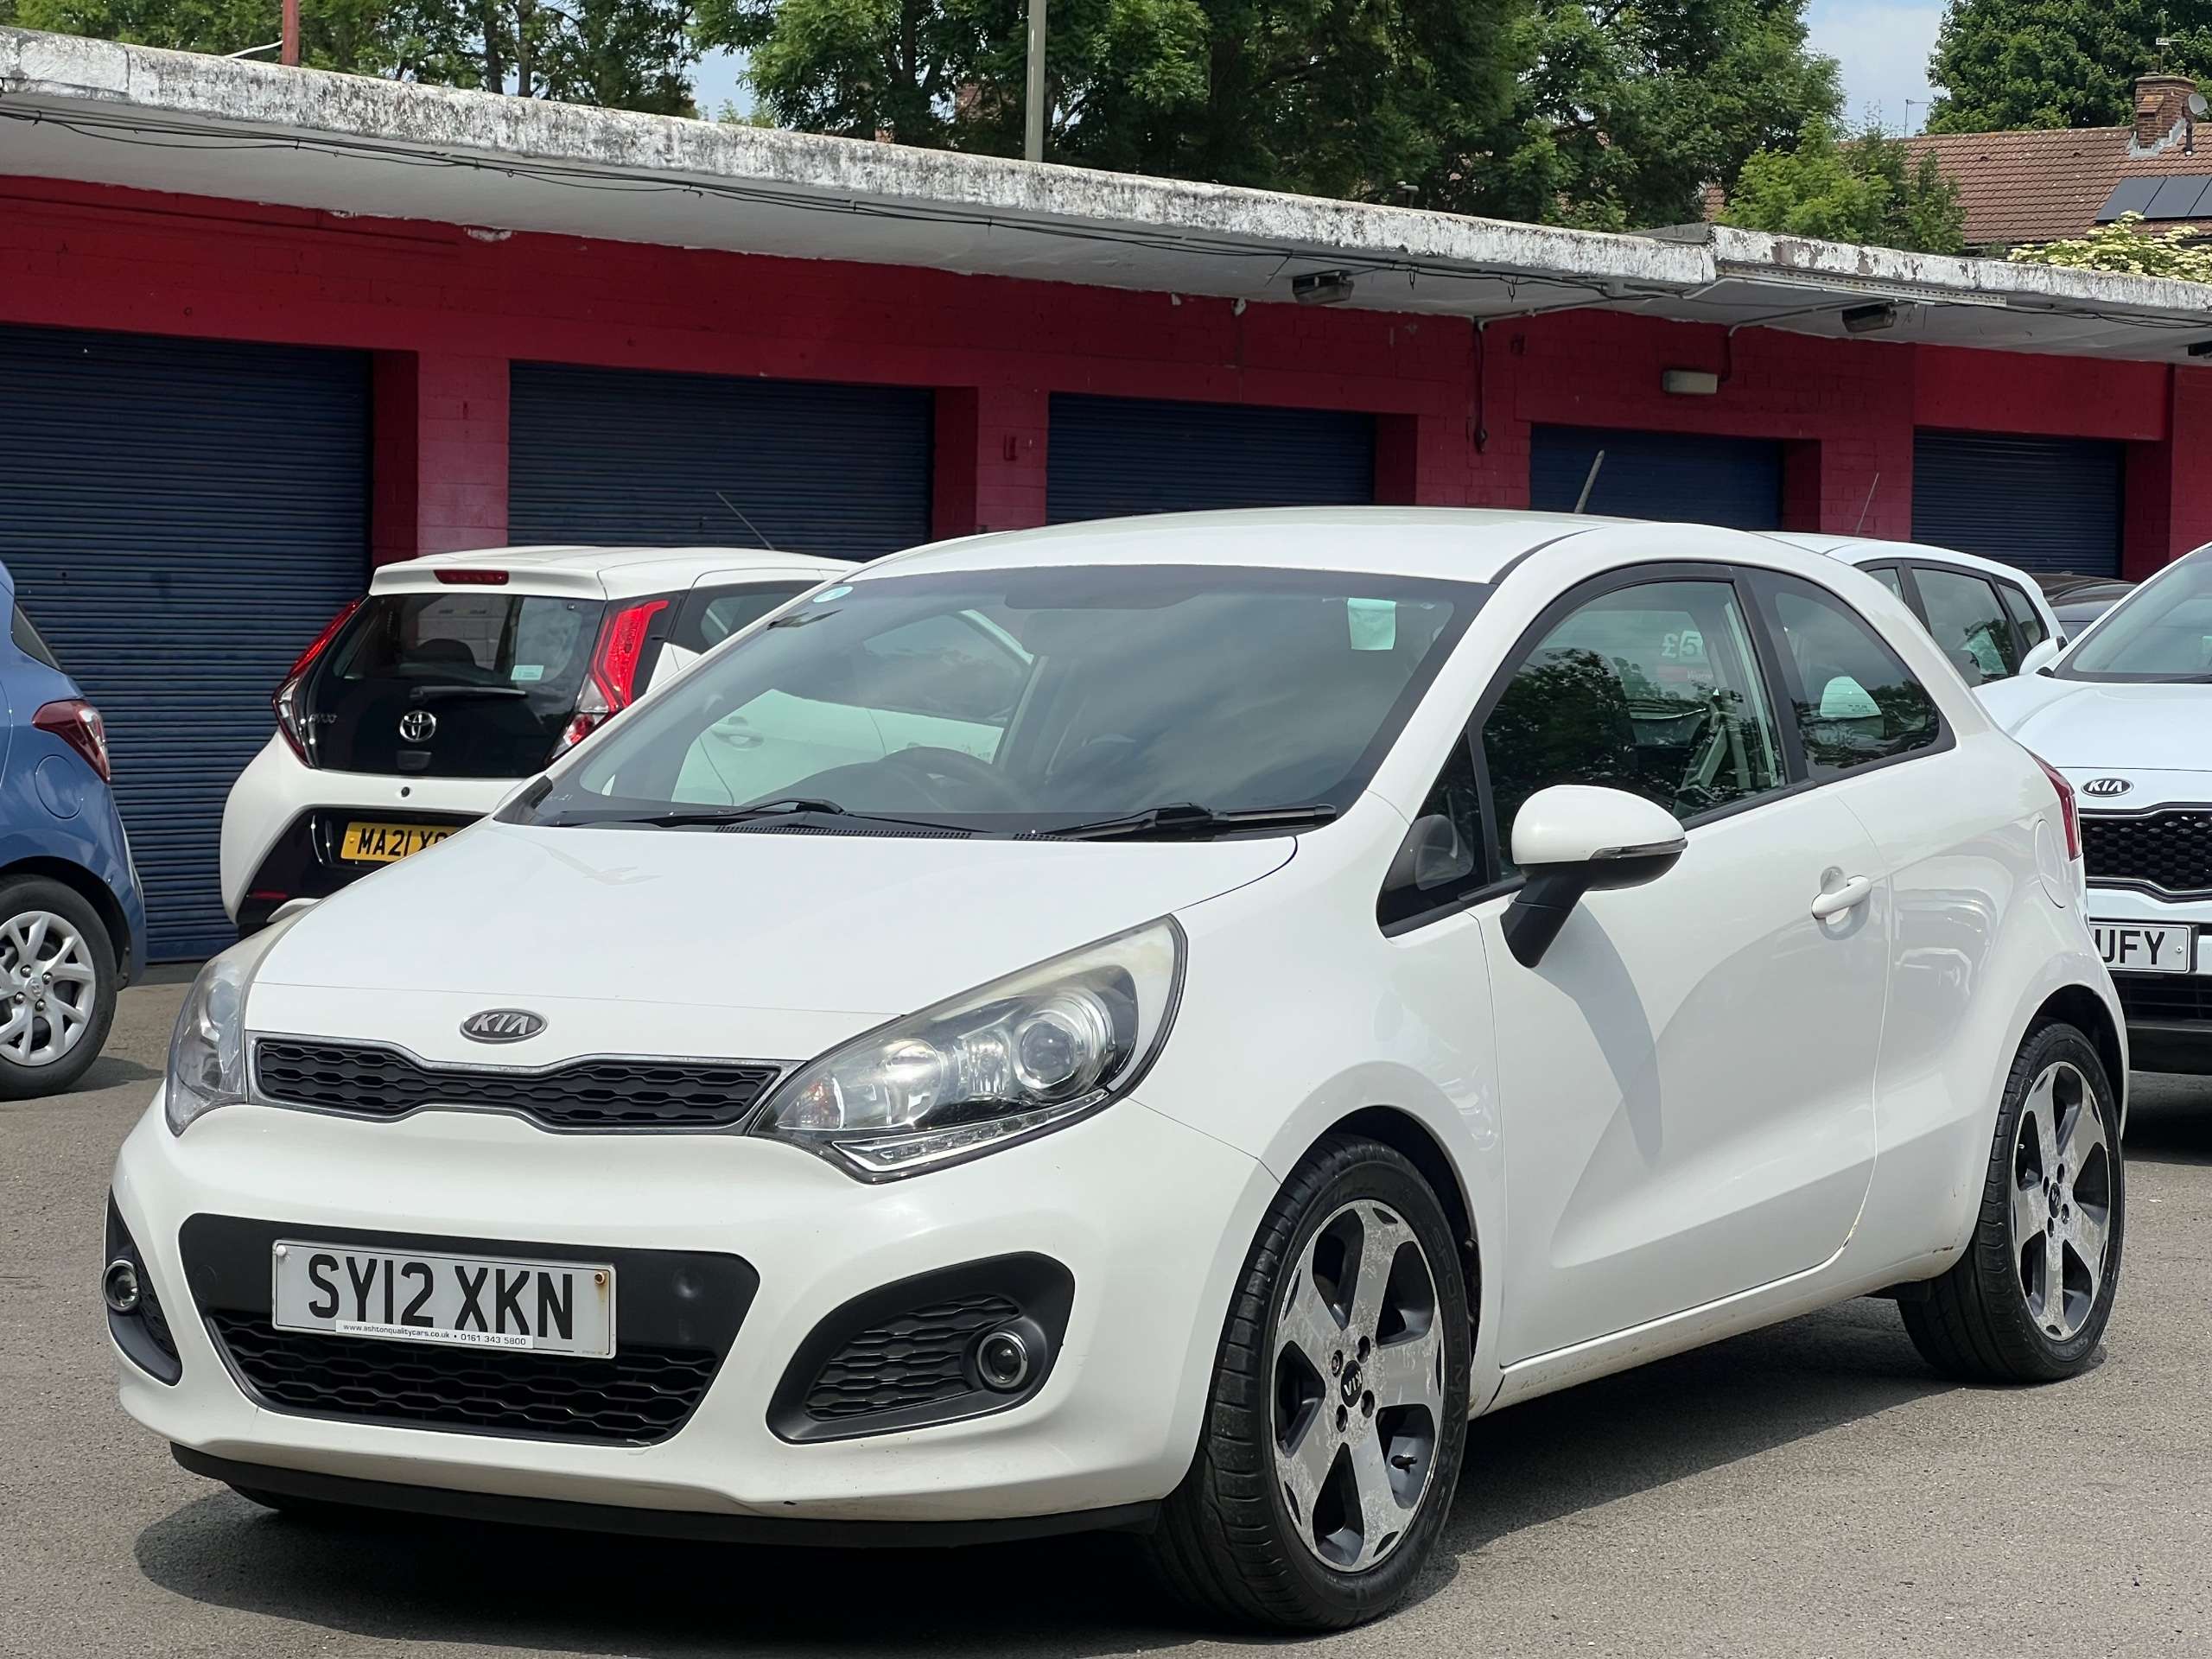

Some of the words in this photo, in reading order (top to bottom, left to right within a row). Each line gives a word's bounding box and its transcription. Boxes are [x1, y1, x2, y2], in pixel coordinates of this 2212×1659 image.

[357, 828, 413, 857] MA21
[2095, 929, 2165, 965] UFY
[308, 1253, 435, 1327] SY12
[454, 1265, 574, 1341] XKN
[343, 1324, 450, 1339] www.ashtonqualitycars.co.uk
[461, 1333, 481, 1343] 0161
[484, 1335, 501, 1344] 343
[504, 1337, 526, 1346] 5800
